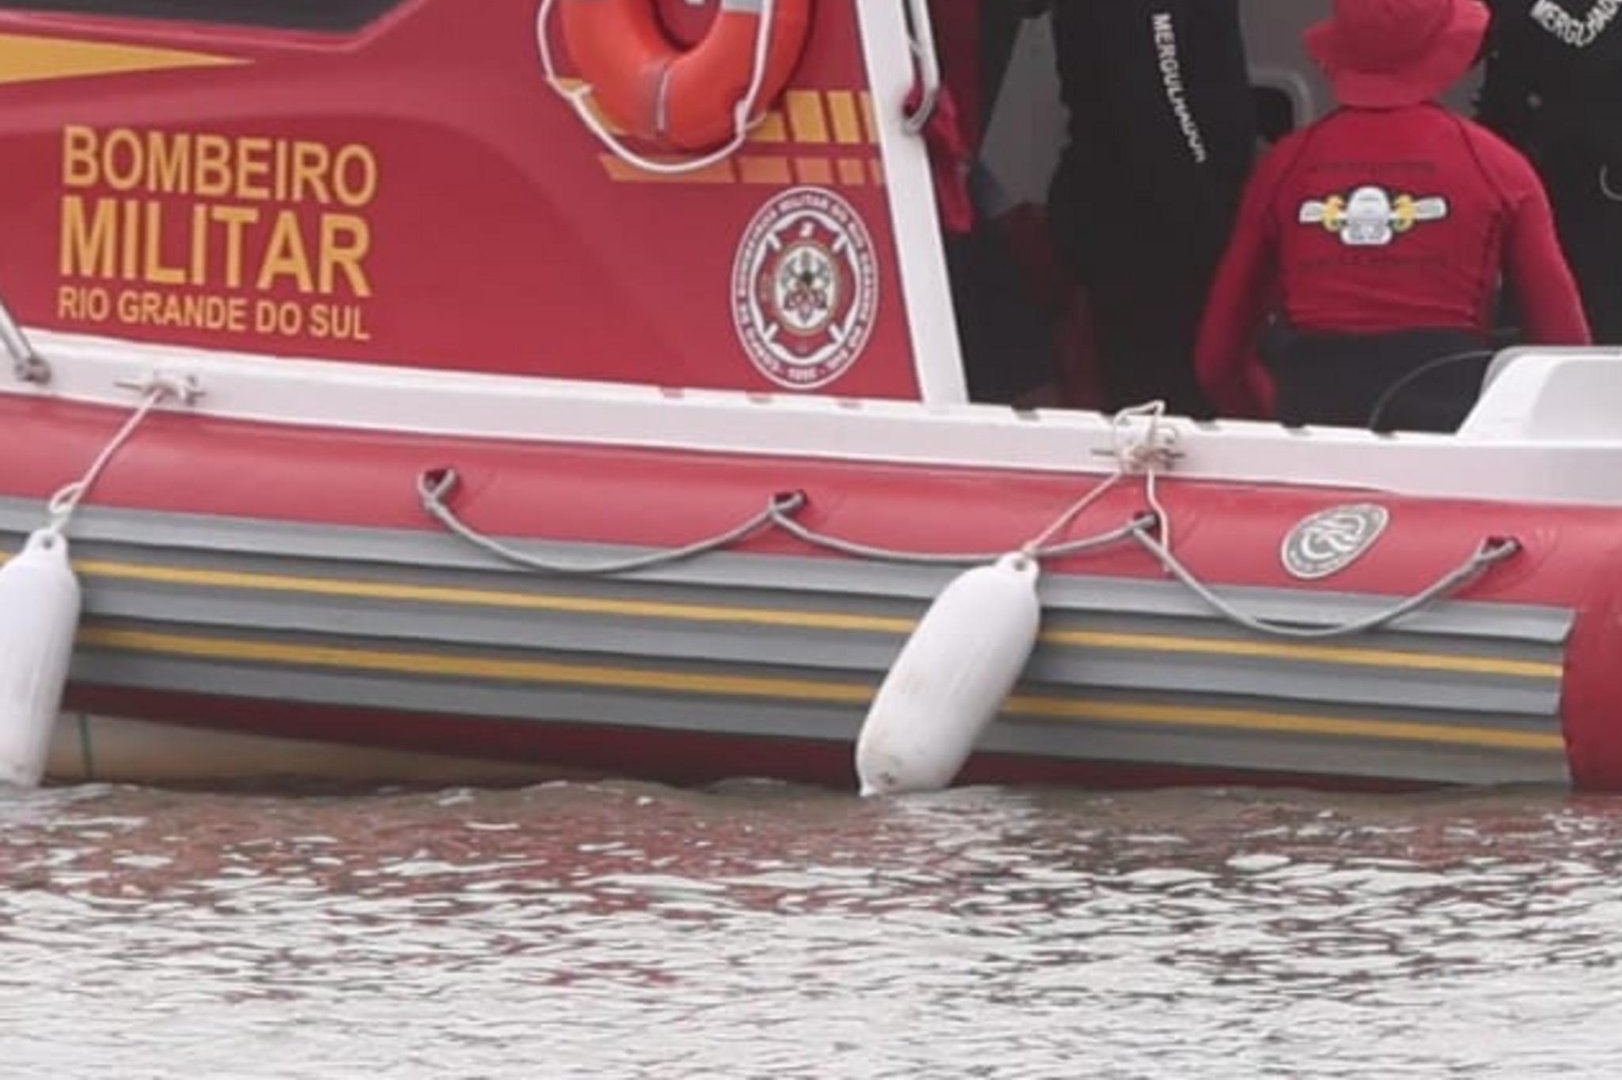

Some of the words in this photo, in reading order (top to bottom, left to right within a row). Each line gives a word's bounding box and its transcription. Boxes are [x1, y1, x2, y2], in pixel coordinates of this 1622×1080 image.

[62, 124, 378, 207] BOMBEIRO
[59, 195, 372, 298] MILITAR
[57, 285, 110, 321] RIO
[117, 289, 247, 332] GRANDE
[255, 300, 302, 336] DO
[309, 304, 371, 341] SUL
